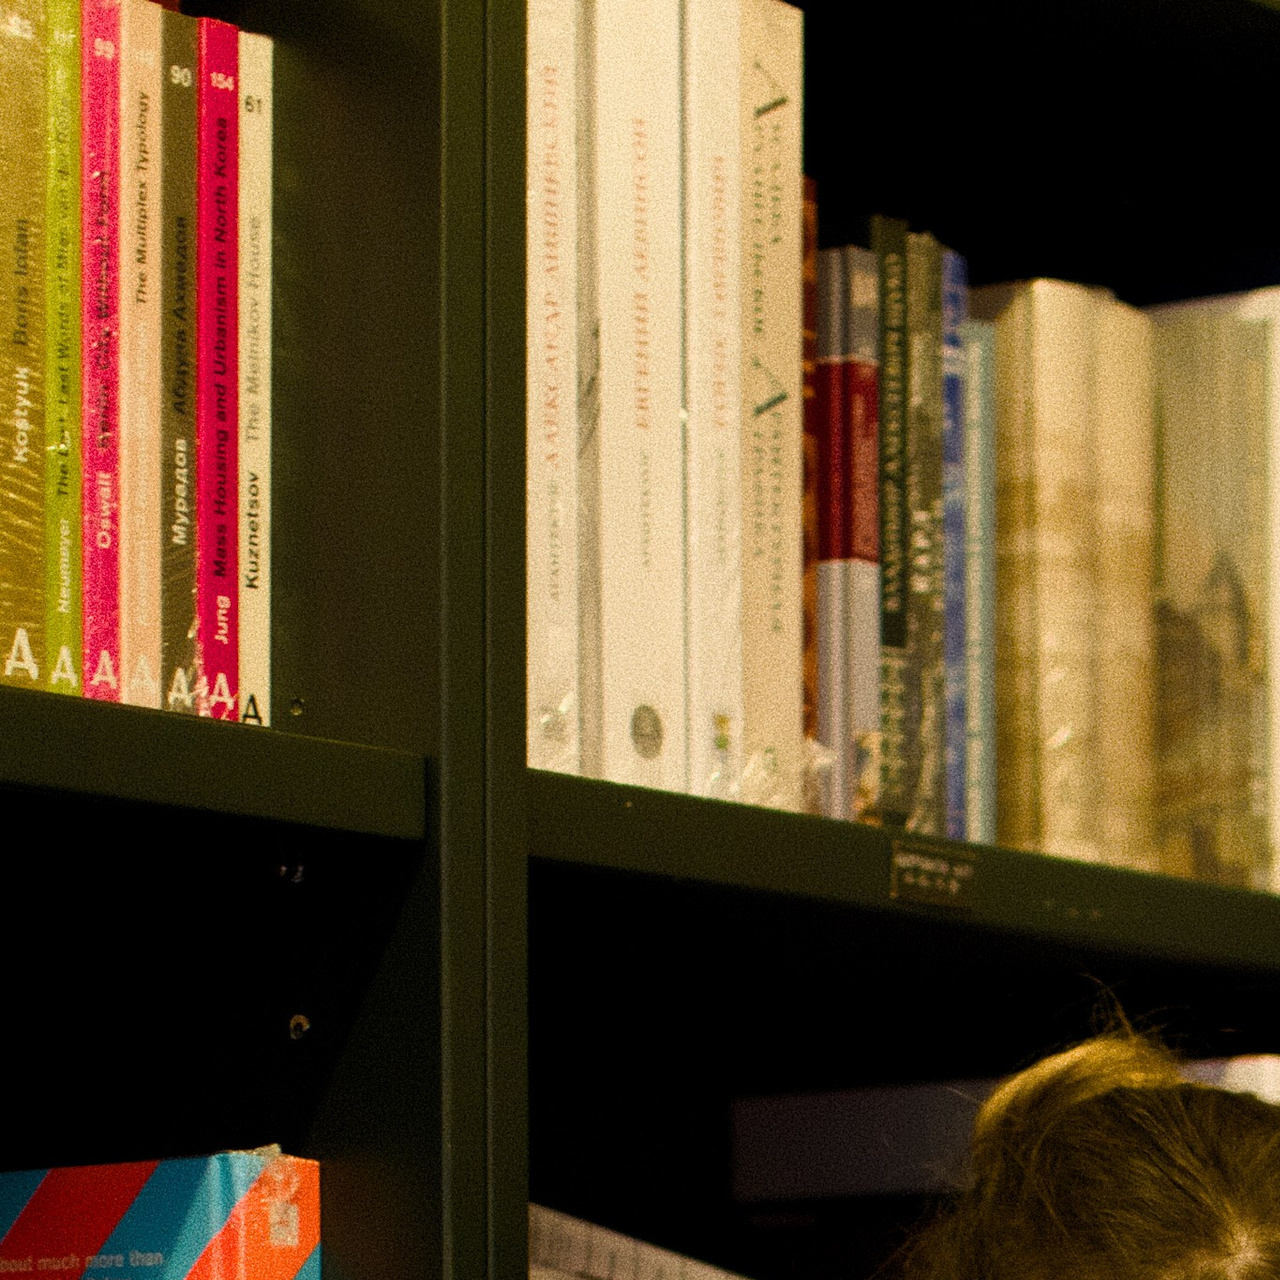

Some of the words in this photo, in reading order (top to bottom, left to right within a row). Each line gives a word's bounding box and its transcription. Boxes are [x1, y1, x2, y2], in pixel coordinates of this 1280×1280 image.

[134, 89, 152, 173] Typology
[212, 116, 228, 178] Korea
[134, 180, 151, 265] Multiplex
[212, 184, 228, 244] North
[246, 215, 261, 290] House
[134, 272, 149, 305] The
[172, 215, 190, 323] Ахмедов
[212, 249, 228, 269] in
[212, 275, 228, 377] Urbanism
[245, 298, 261, 396] Melnikov
[12, 365, 35, 463] Kostyuk
[212, 383, 228, 423] and
[245, 400, 261, 444] The
[172, 437, 190, 546] Мурадов
[212, 428, 231, 517] Housing
[212, 521, 228, 579] Mass
[244, 471, 261, 590] Kuznetsov
[213, 595, 232, 645] Jung
